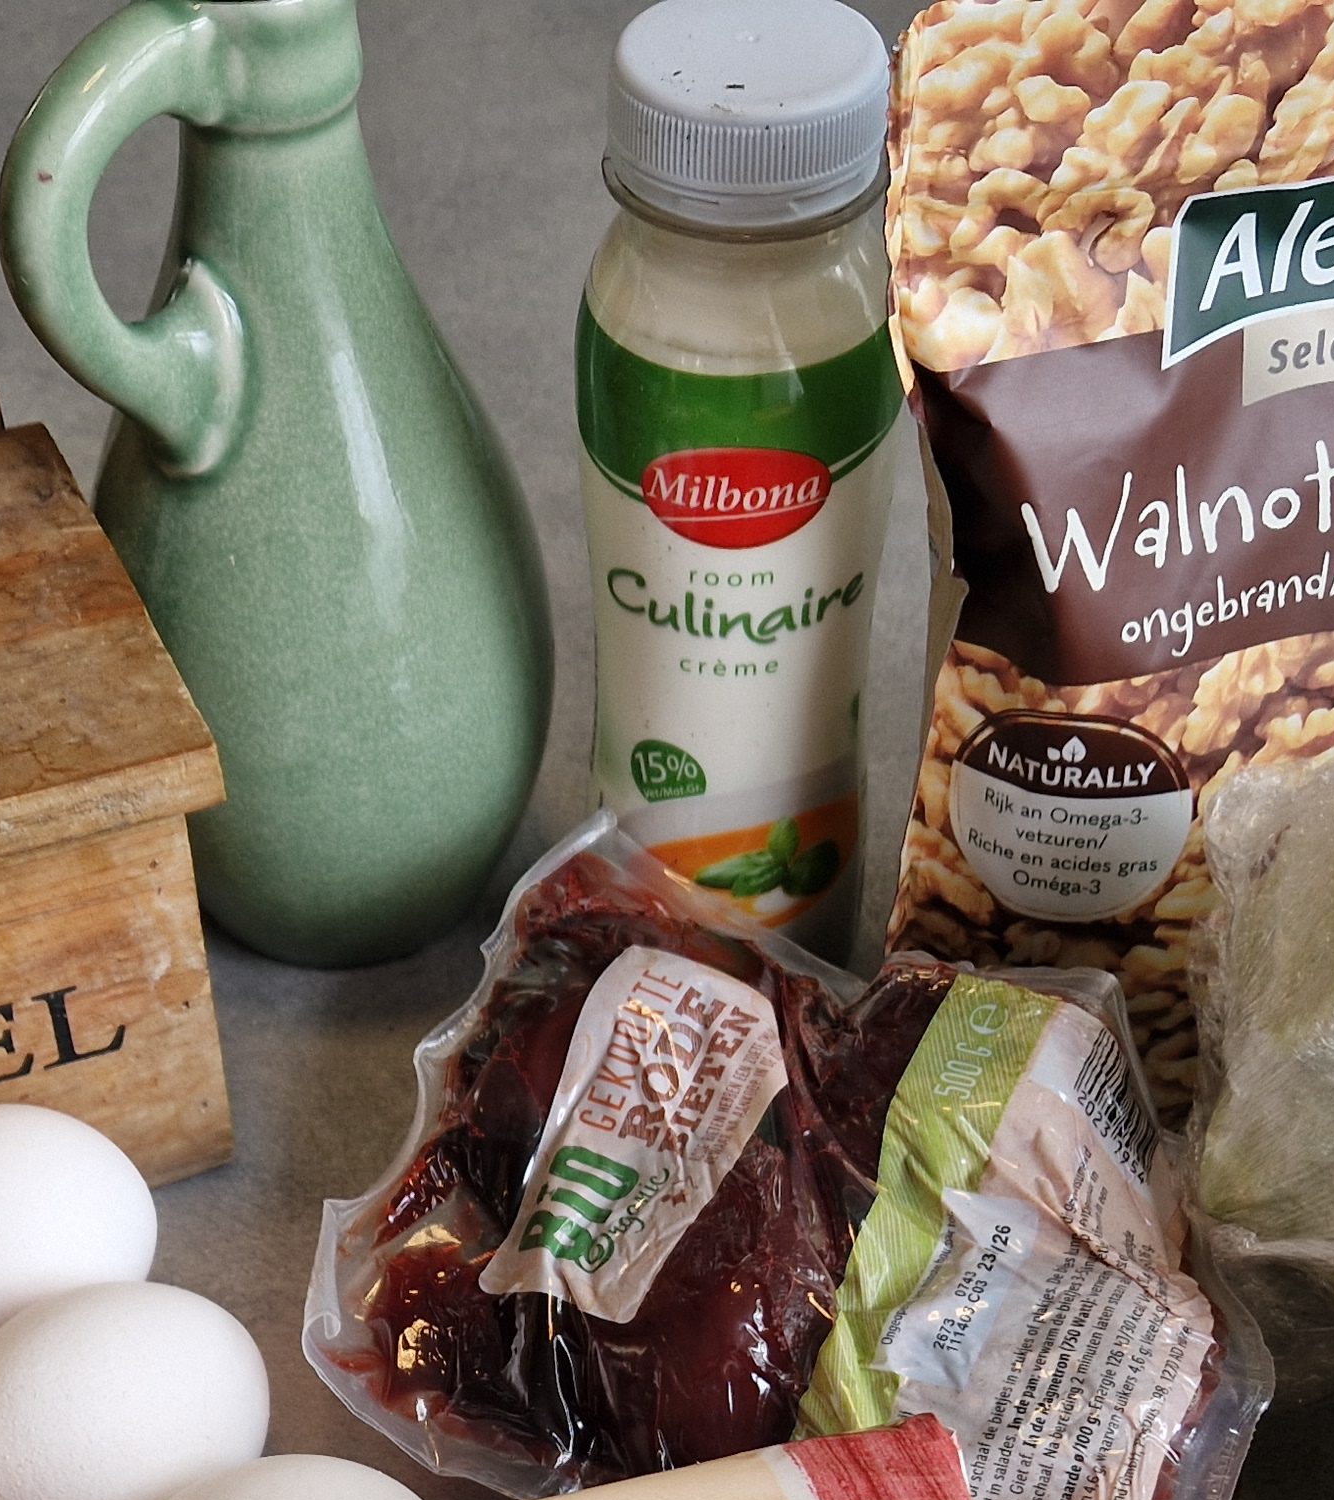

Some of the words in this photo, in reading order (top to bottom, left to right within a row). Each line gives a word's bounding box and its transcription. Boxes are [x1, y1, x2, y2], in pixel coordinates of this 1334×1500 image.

[646, 467, 821, 512] Milbona
[689, 568, 774, 587] room
[606, 568, 864, 645] Culinaire
[679, 656, 780, 680] crème
[634, 750, 698, 784] 15%
[987, 740, 1157, 788] NATURALLY
[984, 787, 1014, 814] Rijk
[1050, 807, 1149, 830] Omega-3-
[968, 828, 1014, 859] Riche
[1020, 853, 1043, 867] en
[1050, 852, 1111, 873] acides
[1117, 859, 1158, 878] gras
[1015, 827, 1109, 850] vetzuren/
[1012, 870, 1101, 896] Oméga-3
[617, 985, 728, 1148] RODE
[657, 1005, 761, 1157] BIETEN
[934, 1054, 983, 1099] 500
[1076, 1090, 1109, 1139] 2023
[1112, 1141, 1147, 1184] 7954
[933, 1317, 955, 1350] 2673
[955, 1271, 976, 1297] 0743
[947, 1306, 976, 1351] 111403
[968, 1280, 988, 1303] C03
[1050, 1311, 1064, 1328] de
[1035, 1327, 1056, 1371] verwarm
[1064, 1328, 1080, 1353] (750
[972, 1436, 991, 1481] schaaf
[985, 1424, 998, 1441] de
[994, 1383, 1013, 1428] bietjes
[1008, 1374, 1017, 1386] in
[1027, 1323, 1040, 1336] of
[1023, 1375, 1042, 1399] pan:
[1044, 1440, 1059, 1459] Na
[1077, 1330, 1103, 1375] minuten
[1097, 1305, 1115, 1331] laten
[1090, 1368, 1117, 1411] Energie
[1106, 1350, 1124, 1368] 126
[1008, 1416, 1022, 1431] In
[1017, 1398, 1029, 1415] de
[1033, 1416, 1046, 1433] de
[1086, 1474, 1099, 1495] 4,6
[1096, 1415, 1121, 1463] waarvan
[1116, 1376, 1138, 1412] suikers
[1127, 1354, 1145, 1375] 4,6
[994, 1436, 1016, 1483] salades.
[1022, 1450, 1035, 1467] af.
[1023, 1432, 1037, 1448] In
[992, 1484, 1002, 1496] in
[1009, 1467, 1028, 1494] Giet
